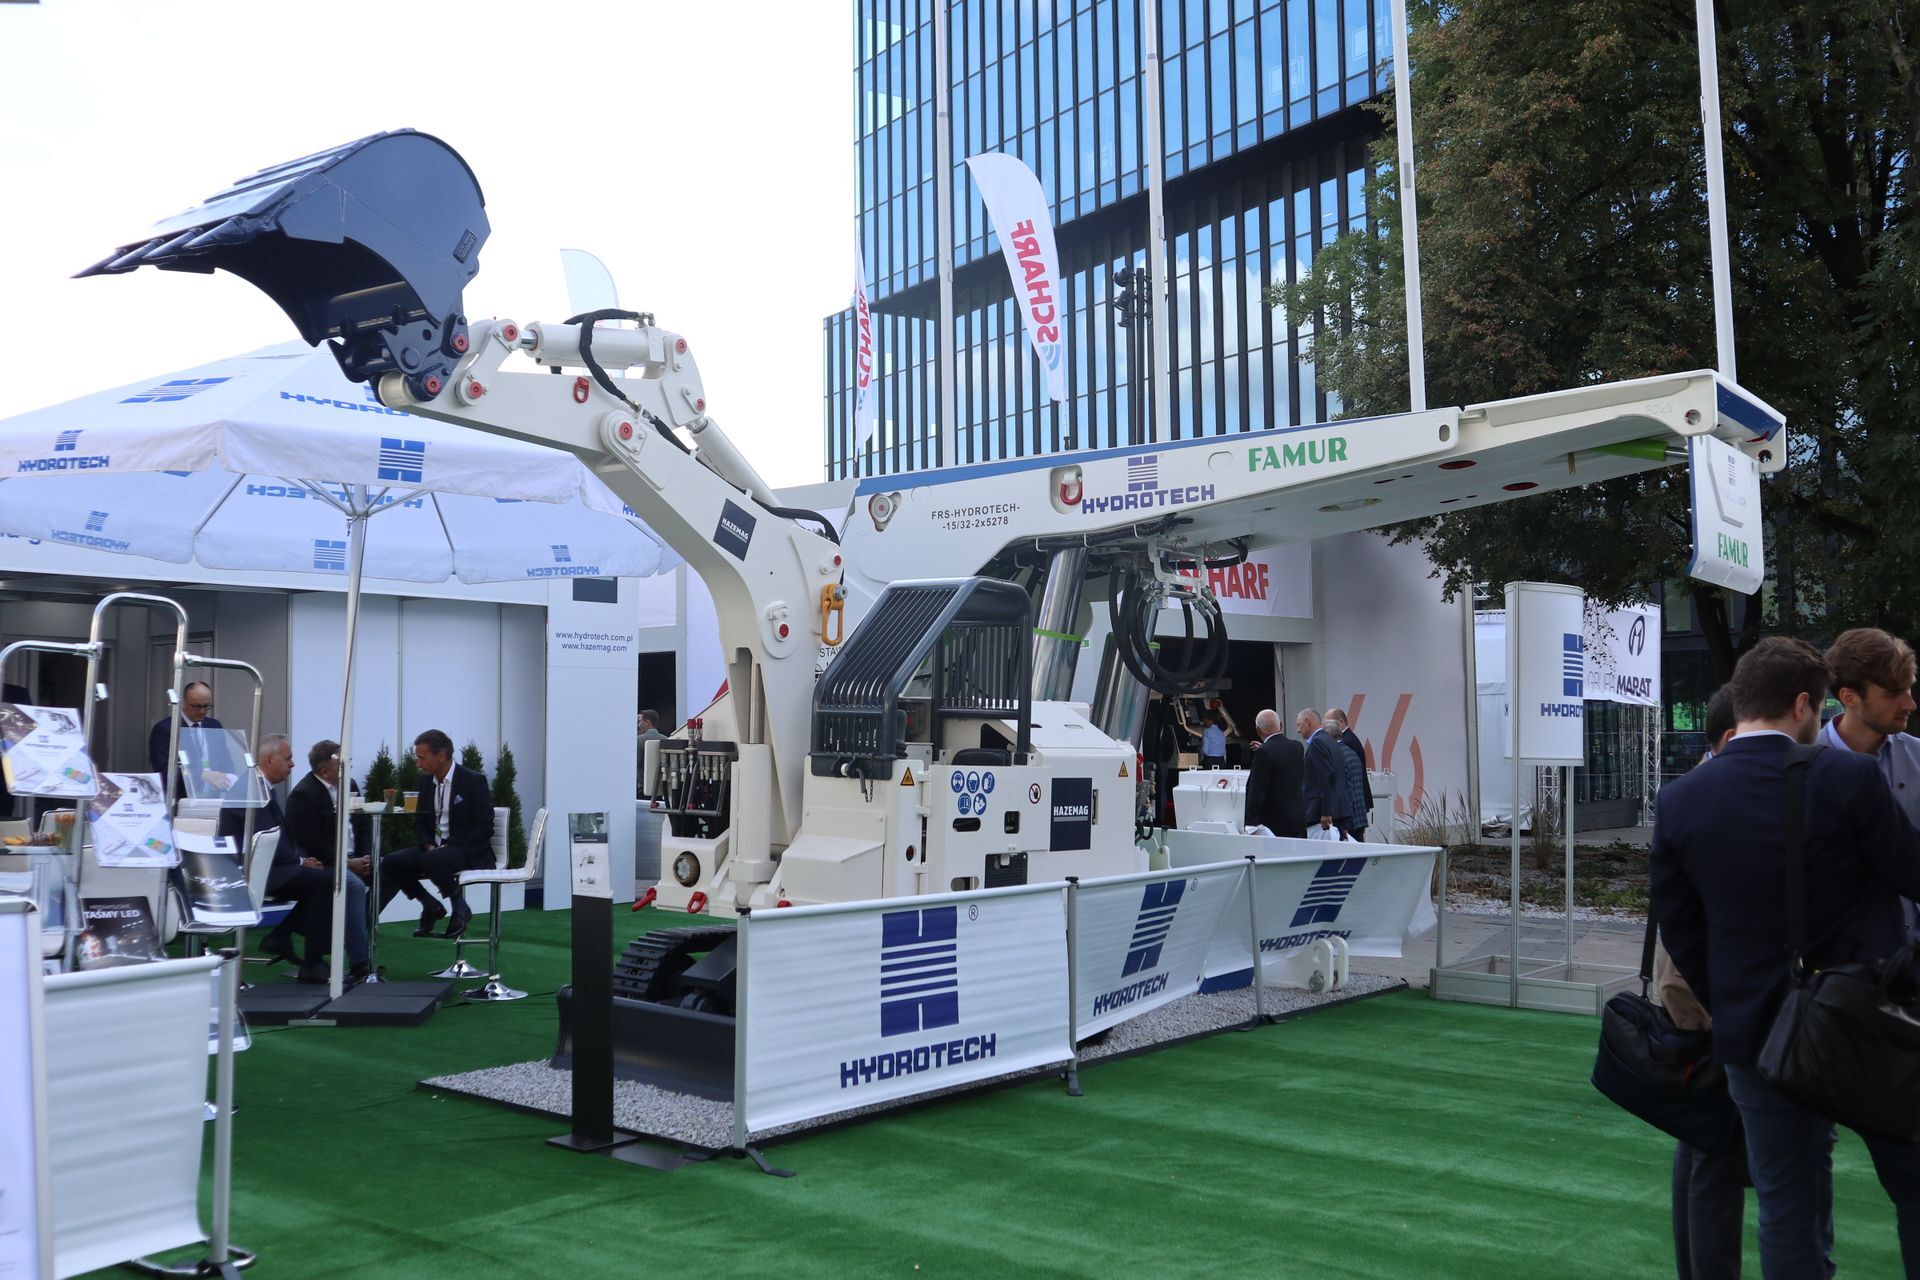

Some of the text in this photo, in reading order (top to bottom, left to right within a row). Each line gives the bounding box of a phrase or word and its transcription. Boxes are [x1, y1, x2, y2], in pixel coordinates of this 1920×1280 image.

[859, 287, 872, 388] SCHAR
[280, 391, 425, 418] HYDRO
[17, 456, 110, 472] HYDROTECH
[1248, 437, 1348, 472] FAMUR
[931, 503, 1020, 519] FRS-HYDROTECH-
[1082, 484, 1215, 514] HYDROTECH
[721, 517, 750, 541] HAZEMAG
[942, 516, 1009, 530] -15/32-2x5278
[1718, 532, 1748, 568] FAMUR
[1178, 558, 1269, 600] HARF
[555, 631, 634, 643] www.hydrotech.com.pl
[561, 642, 628, 653] www.hazemag.com
[1616, 674, 1652, 697] MARAT
[1053, 805, 1089, 817] HAZEMAG
[83, 909, 141, 919] TAŚMY LED
[1093, 972, 1169, 1016] HYDROTECH
[840, 1033, 997, 1088] HYDROTECH
